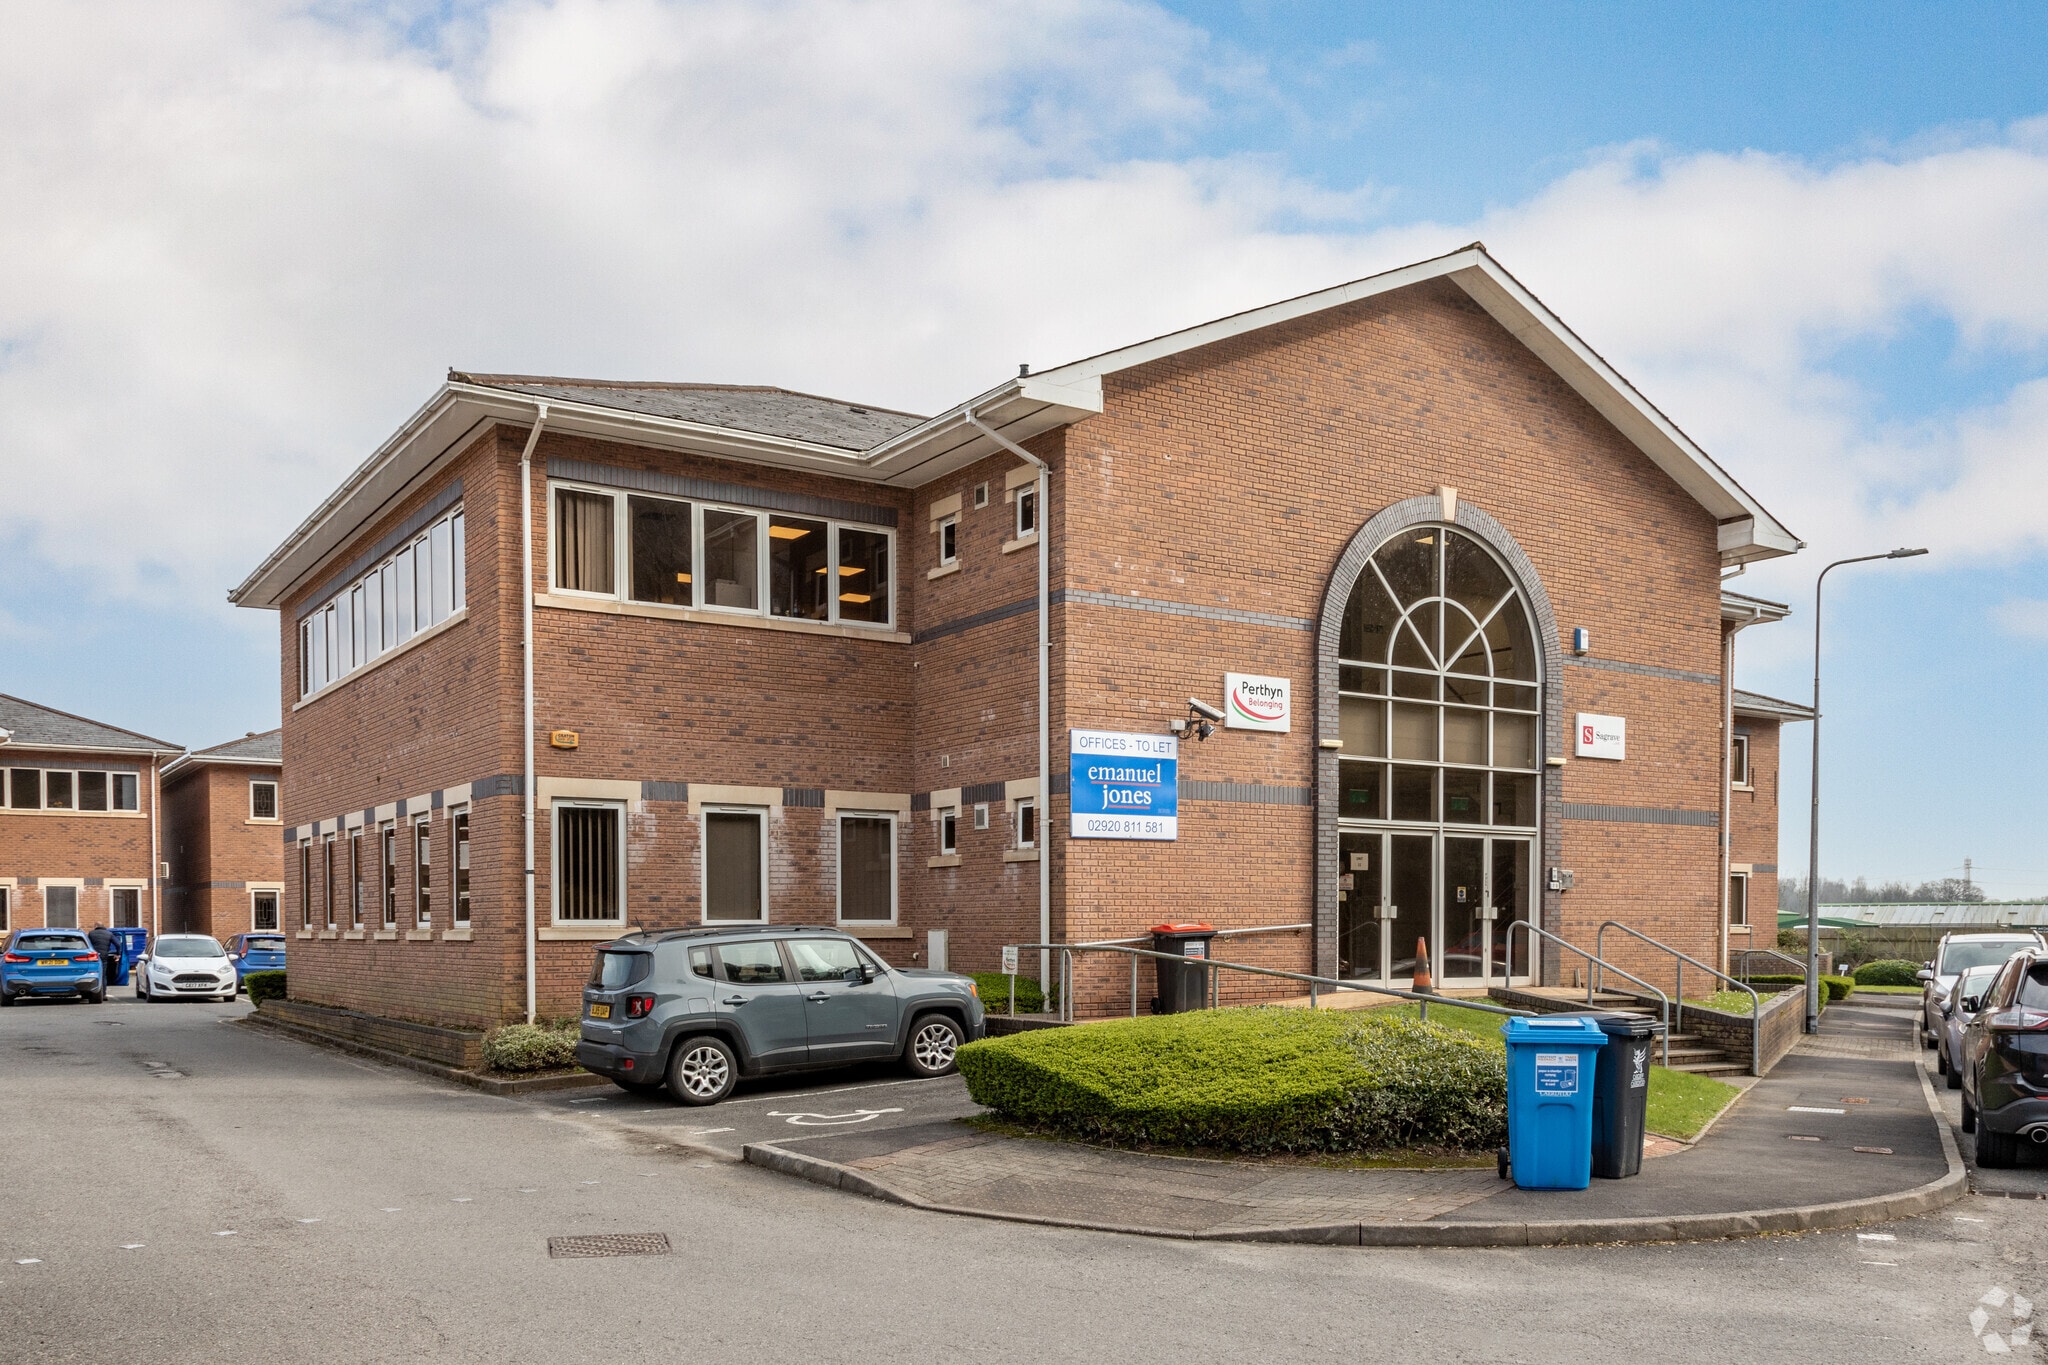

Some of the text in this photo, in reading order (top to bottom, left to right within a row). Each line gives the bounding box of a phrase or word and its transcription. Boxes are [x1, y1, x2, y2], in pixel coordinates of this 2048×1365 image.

[1242, 681, 1283, 699] Perthyn
[1249, 697, 1283, 710] Belonging
[1079, 736, 1127, 750] OFFICES
[1135, 740, 1150, 752] TO
[1153, 741, 1172, 753] LET
[1595, 730, 1620, 742] Sagrave
[1088, 763, 1161, 783] emanuel
[1102, 784, 1152, 810] jones
[1087, 820, 1163, 833] 02920 811 581
